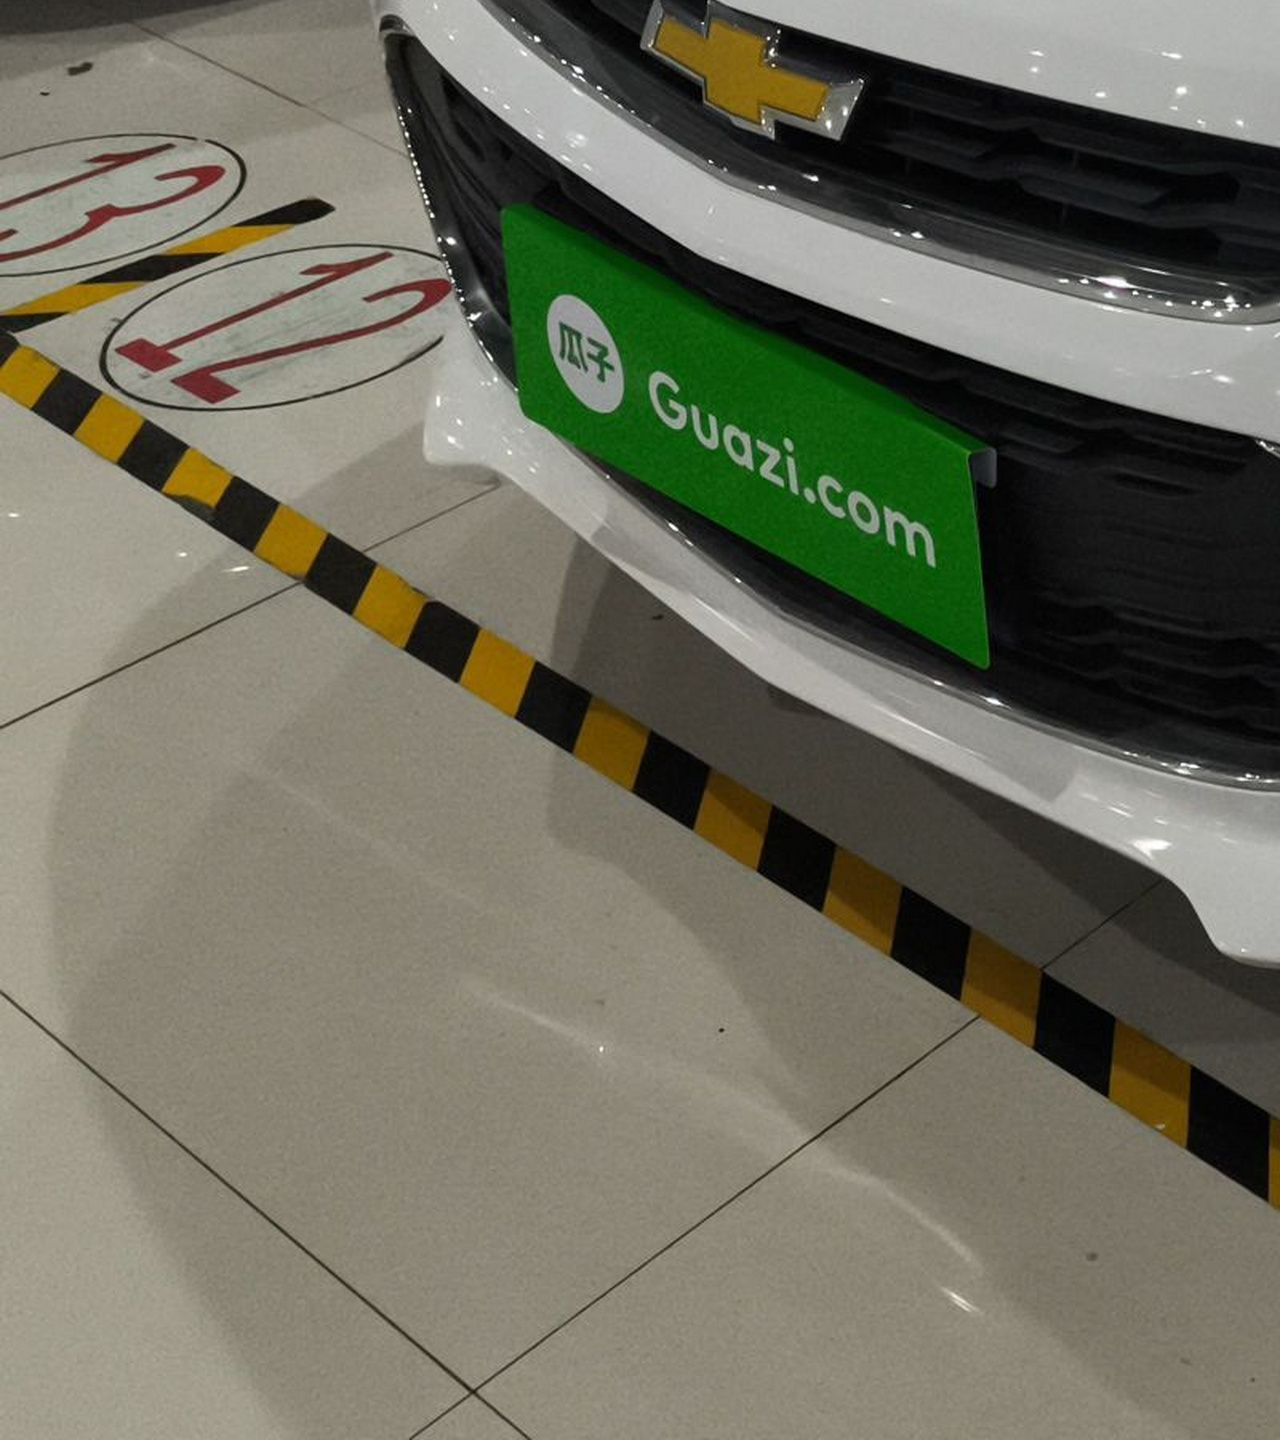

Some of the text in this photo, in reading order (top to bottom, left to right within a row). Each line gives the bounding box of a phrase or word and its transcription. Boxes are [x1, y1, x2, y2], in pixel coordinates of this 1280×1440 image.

[115, 251, 454, 405] 12
[558, 321, 616, 383] 瓜子
[648, 370, 938, 569] Guazi.com
